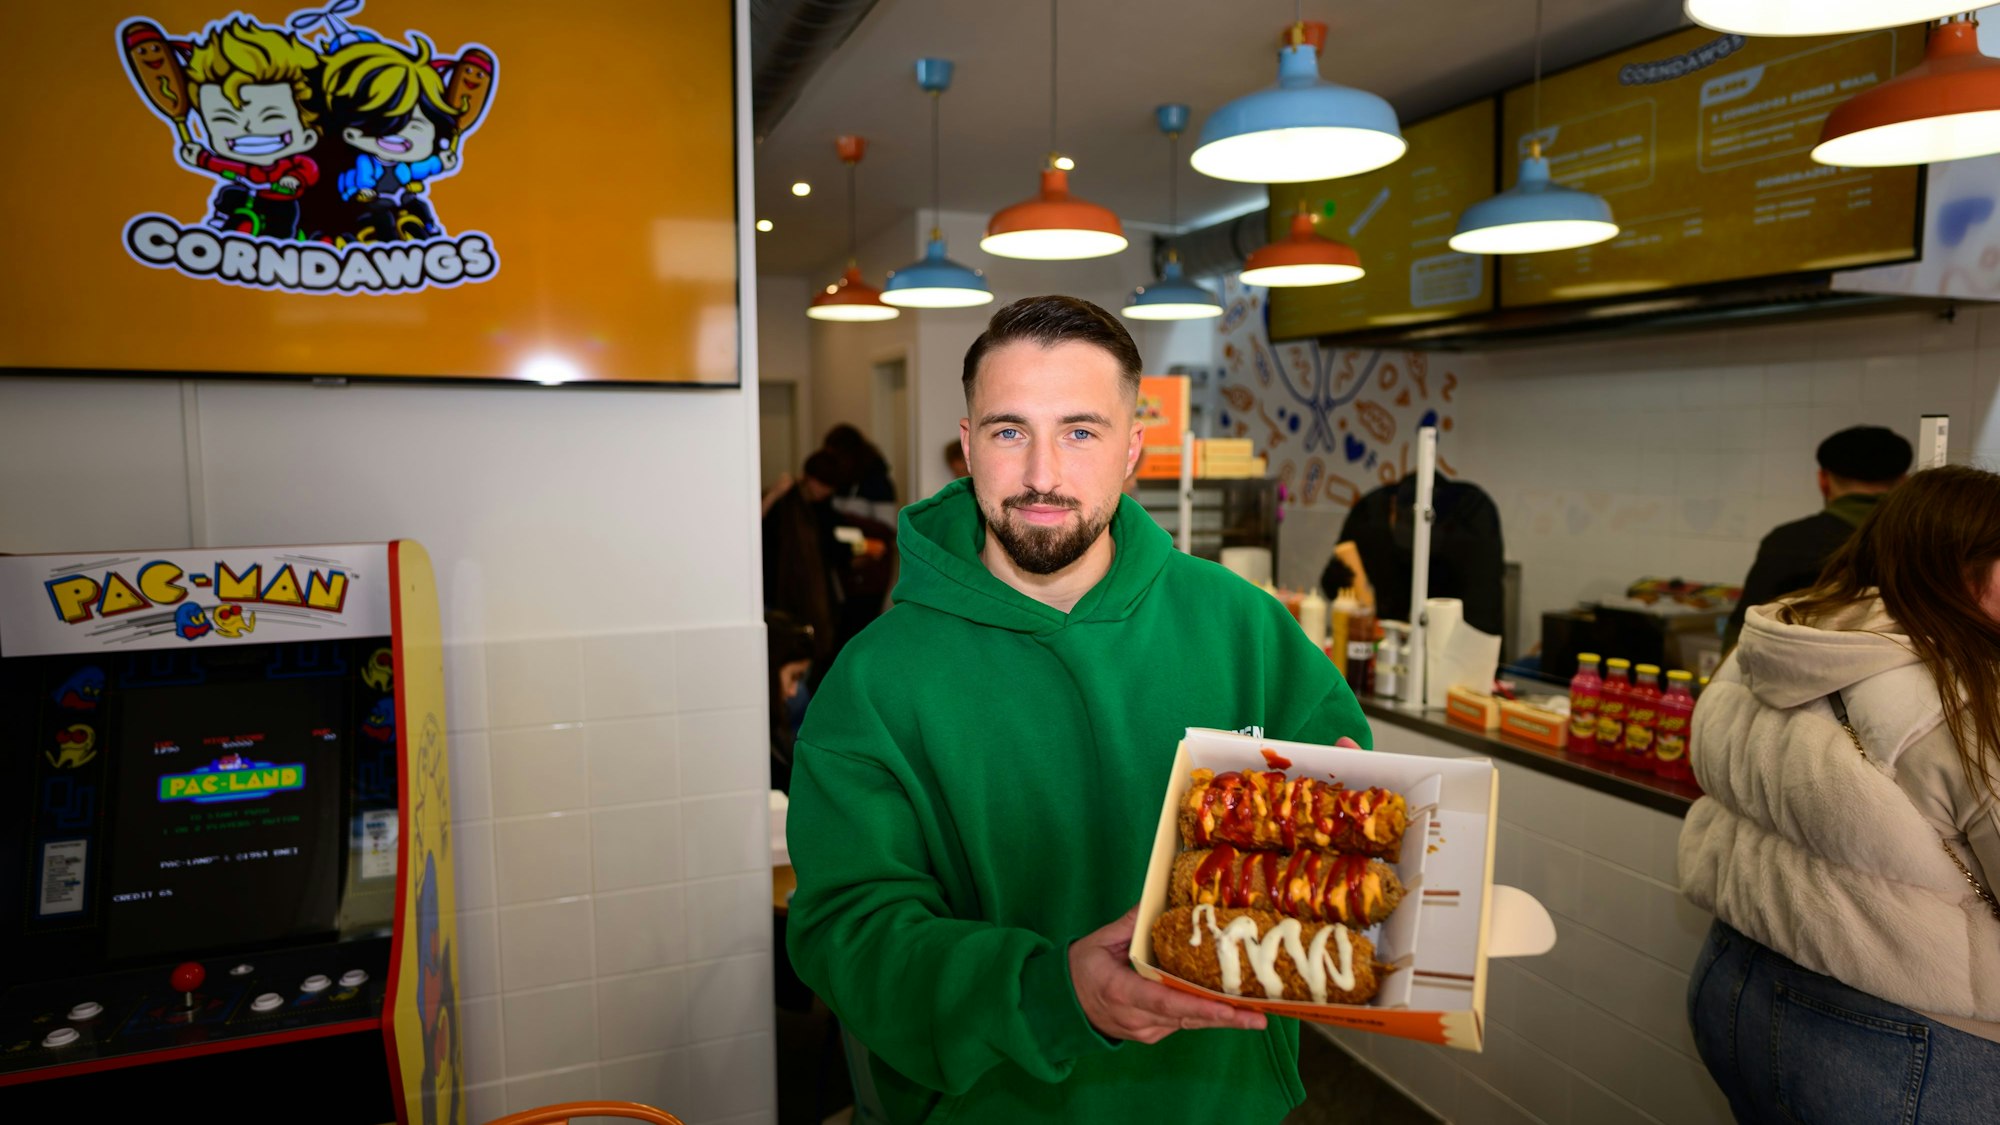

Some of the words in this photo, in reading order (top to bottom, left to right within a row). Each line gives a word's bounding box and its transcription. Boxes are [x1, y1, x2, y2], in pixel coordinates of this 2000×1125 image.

[130, 217, 495, 291] CORNDAWGS
[44, 559, 350, 625] PAC-MAN
[169, 768, 298, 798] PAC-LAND
[112, 889, 155, 904] CREDIT
